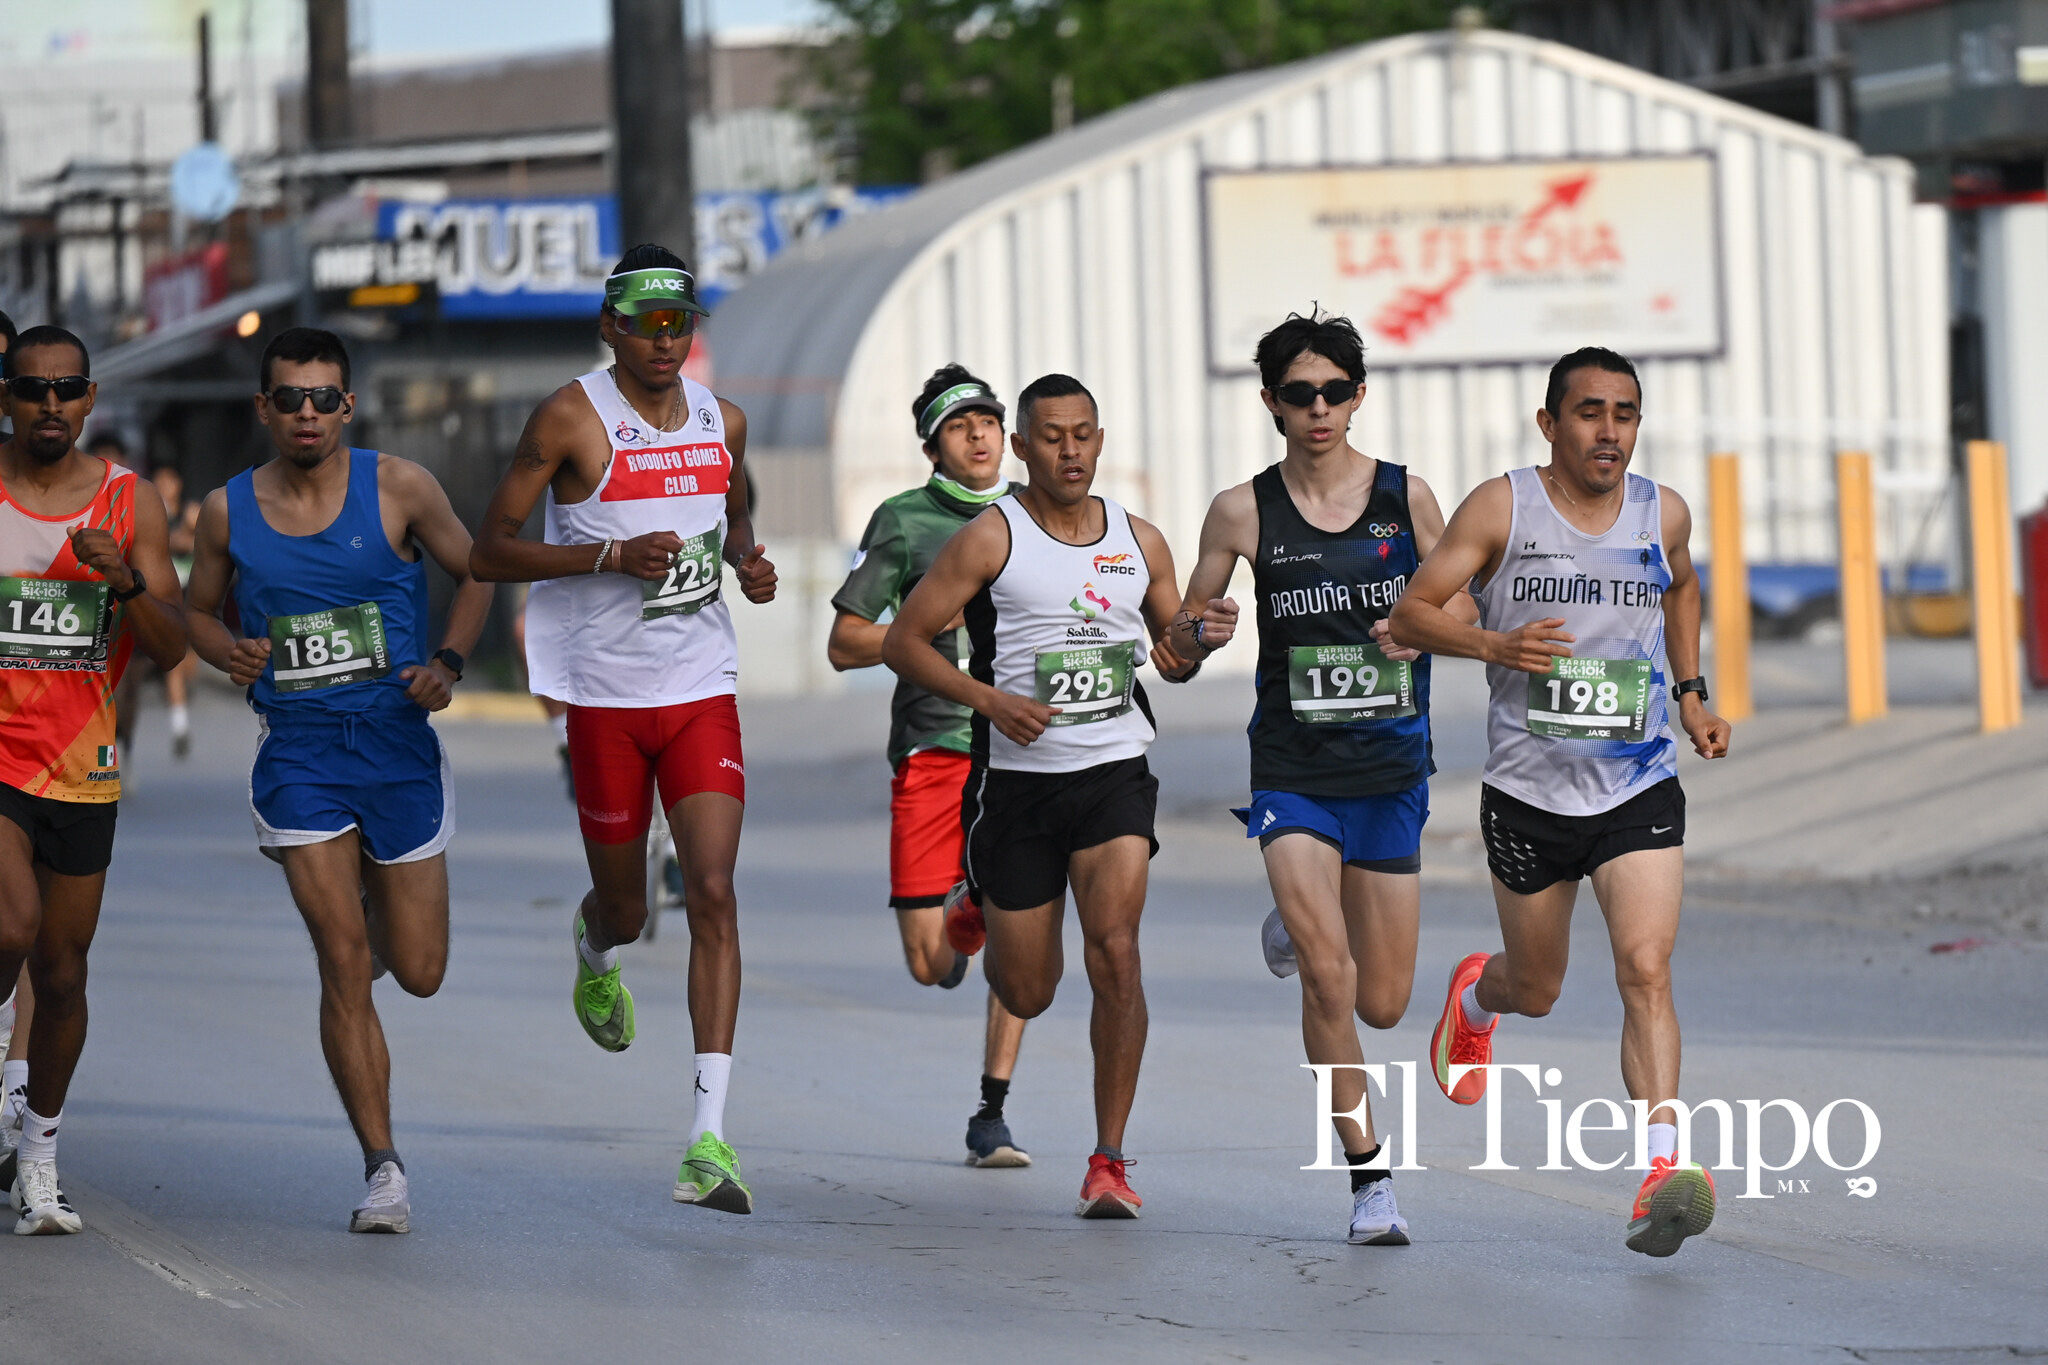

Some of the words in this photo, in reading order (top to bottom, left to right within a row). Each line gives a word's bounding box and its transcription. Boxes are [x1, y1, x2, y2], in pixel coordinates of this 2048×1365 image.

[626, 451, 683, 473] RODOLFO
[683, 446, 722, 468] GÓMEZ
[664, 475, 698, 495] CLUB
[658, 551, 714, 597] 225
[1100, 565, 1136, 576] CROC
[1271, 553, 1322, 565] ARTURO
[21, 580, 68, 589] CARRERA
[1270, 581, 1352, 618] ORDUÑA
[1356, 574, 1406, 609] TEAM
[1512, 573, 1601, 605] ORDUÑA
[1610, 579, 1664, 609] TEAM
[8, 600, 80, 635] 146
[94, 598, 105, 649] MEDALLA
[290, 612, 333, 624] CARRERA
[364, 606, 378, 615] 185
[284, 629, 354, 668] 185
[369, 619, 386, 669] MEDALLA
[1066, 626, 1108, 639] Saltillo
[31, 661, 77, 670] LETICIA
[1063, 650, 1103, 658] CARRERA
[1559, 659, 1606, 667] CARRERA
[1049, 667, 1113, 702] 295
[1307, 665, 1379, 698] 199
[1399, 660, 1409, 706] MEDALL
[1546, 679, 1619, 715] 198
[1634, 678, 1647, 731] MEDALLA
